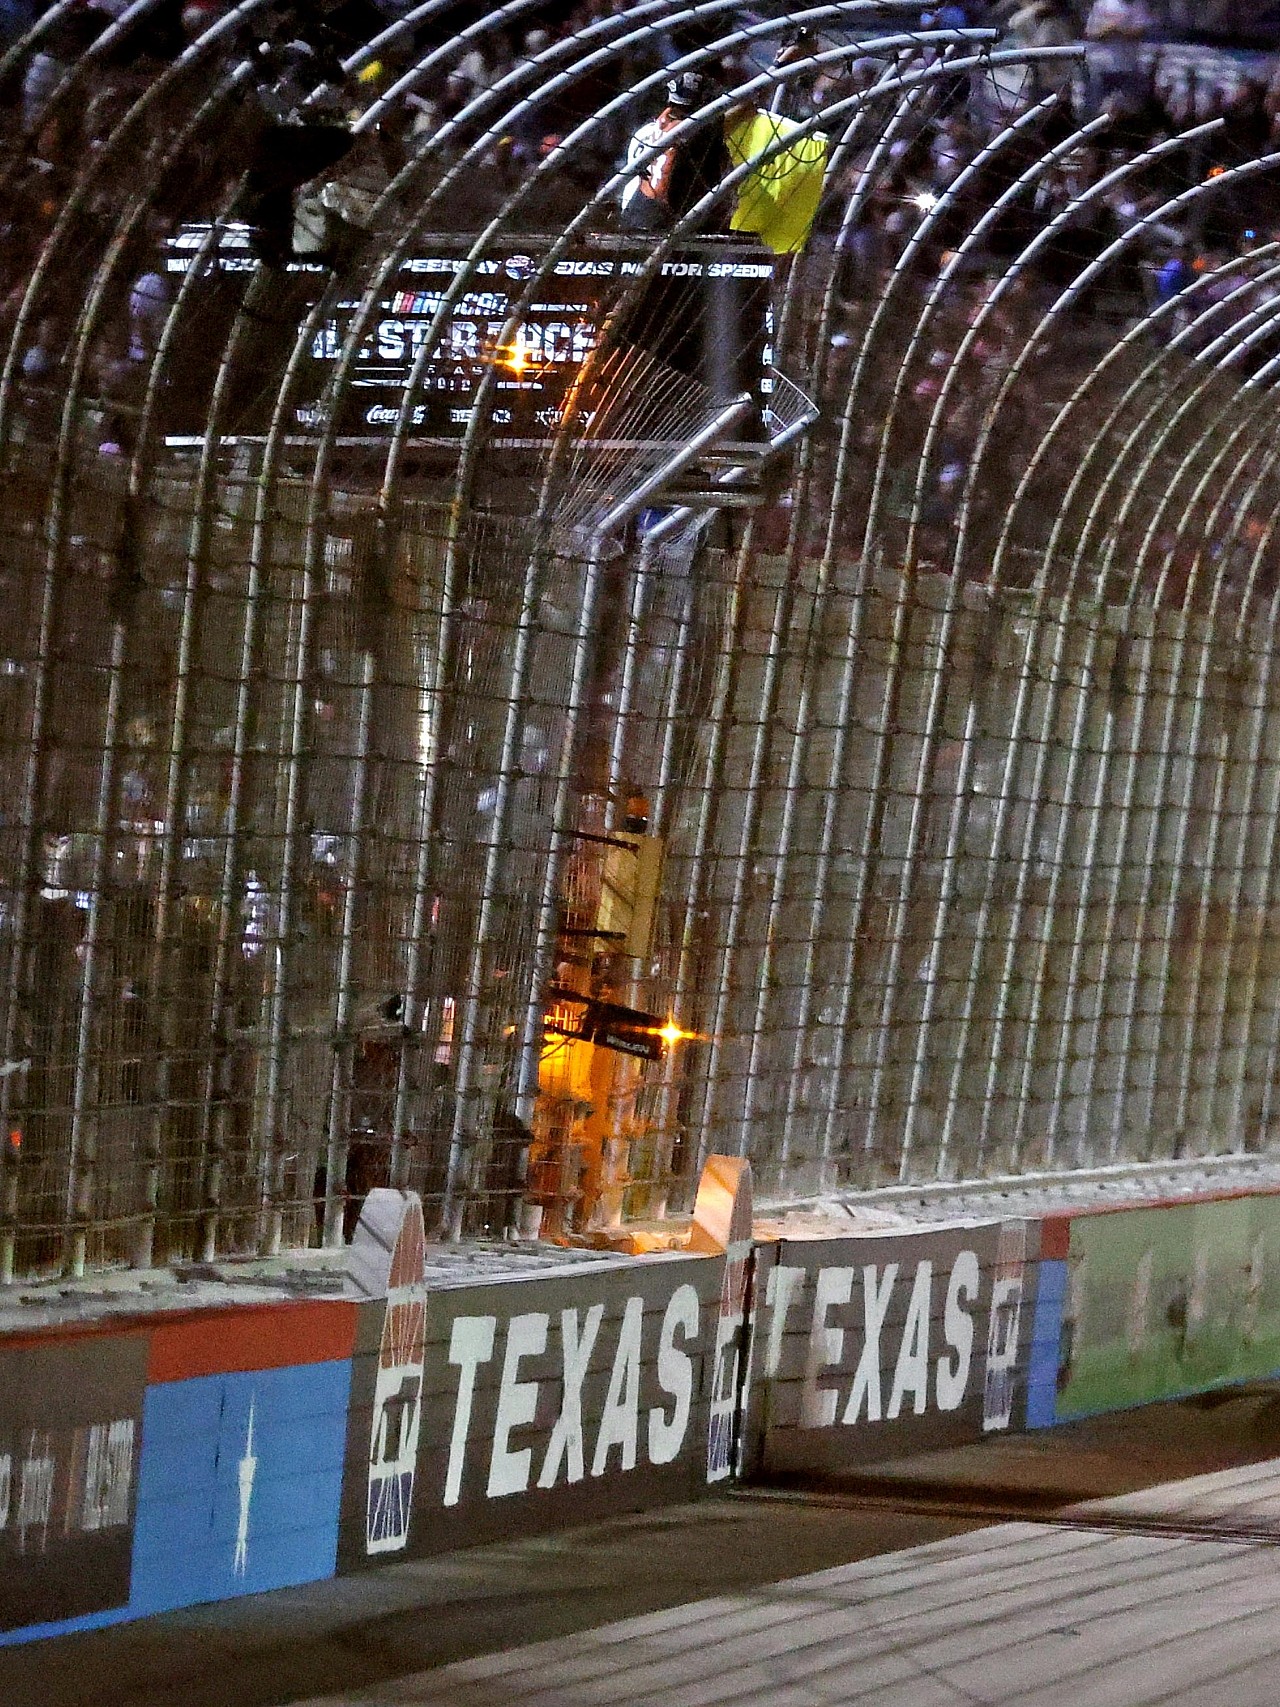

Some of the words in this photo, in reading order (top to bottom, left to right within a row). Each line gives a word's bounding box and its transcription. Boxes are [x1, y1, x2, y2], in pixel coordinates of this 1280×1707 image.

[620, 262, 703, 276] MTOR
[443, 1284, 700, 1507] TEXAS
[765, 1250, 980, 1428] TEXAS
